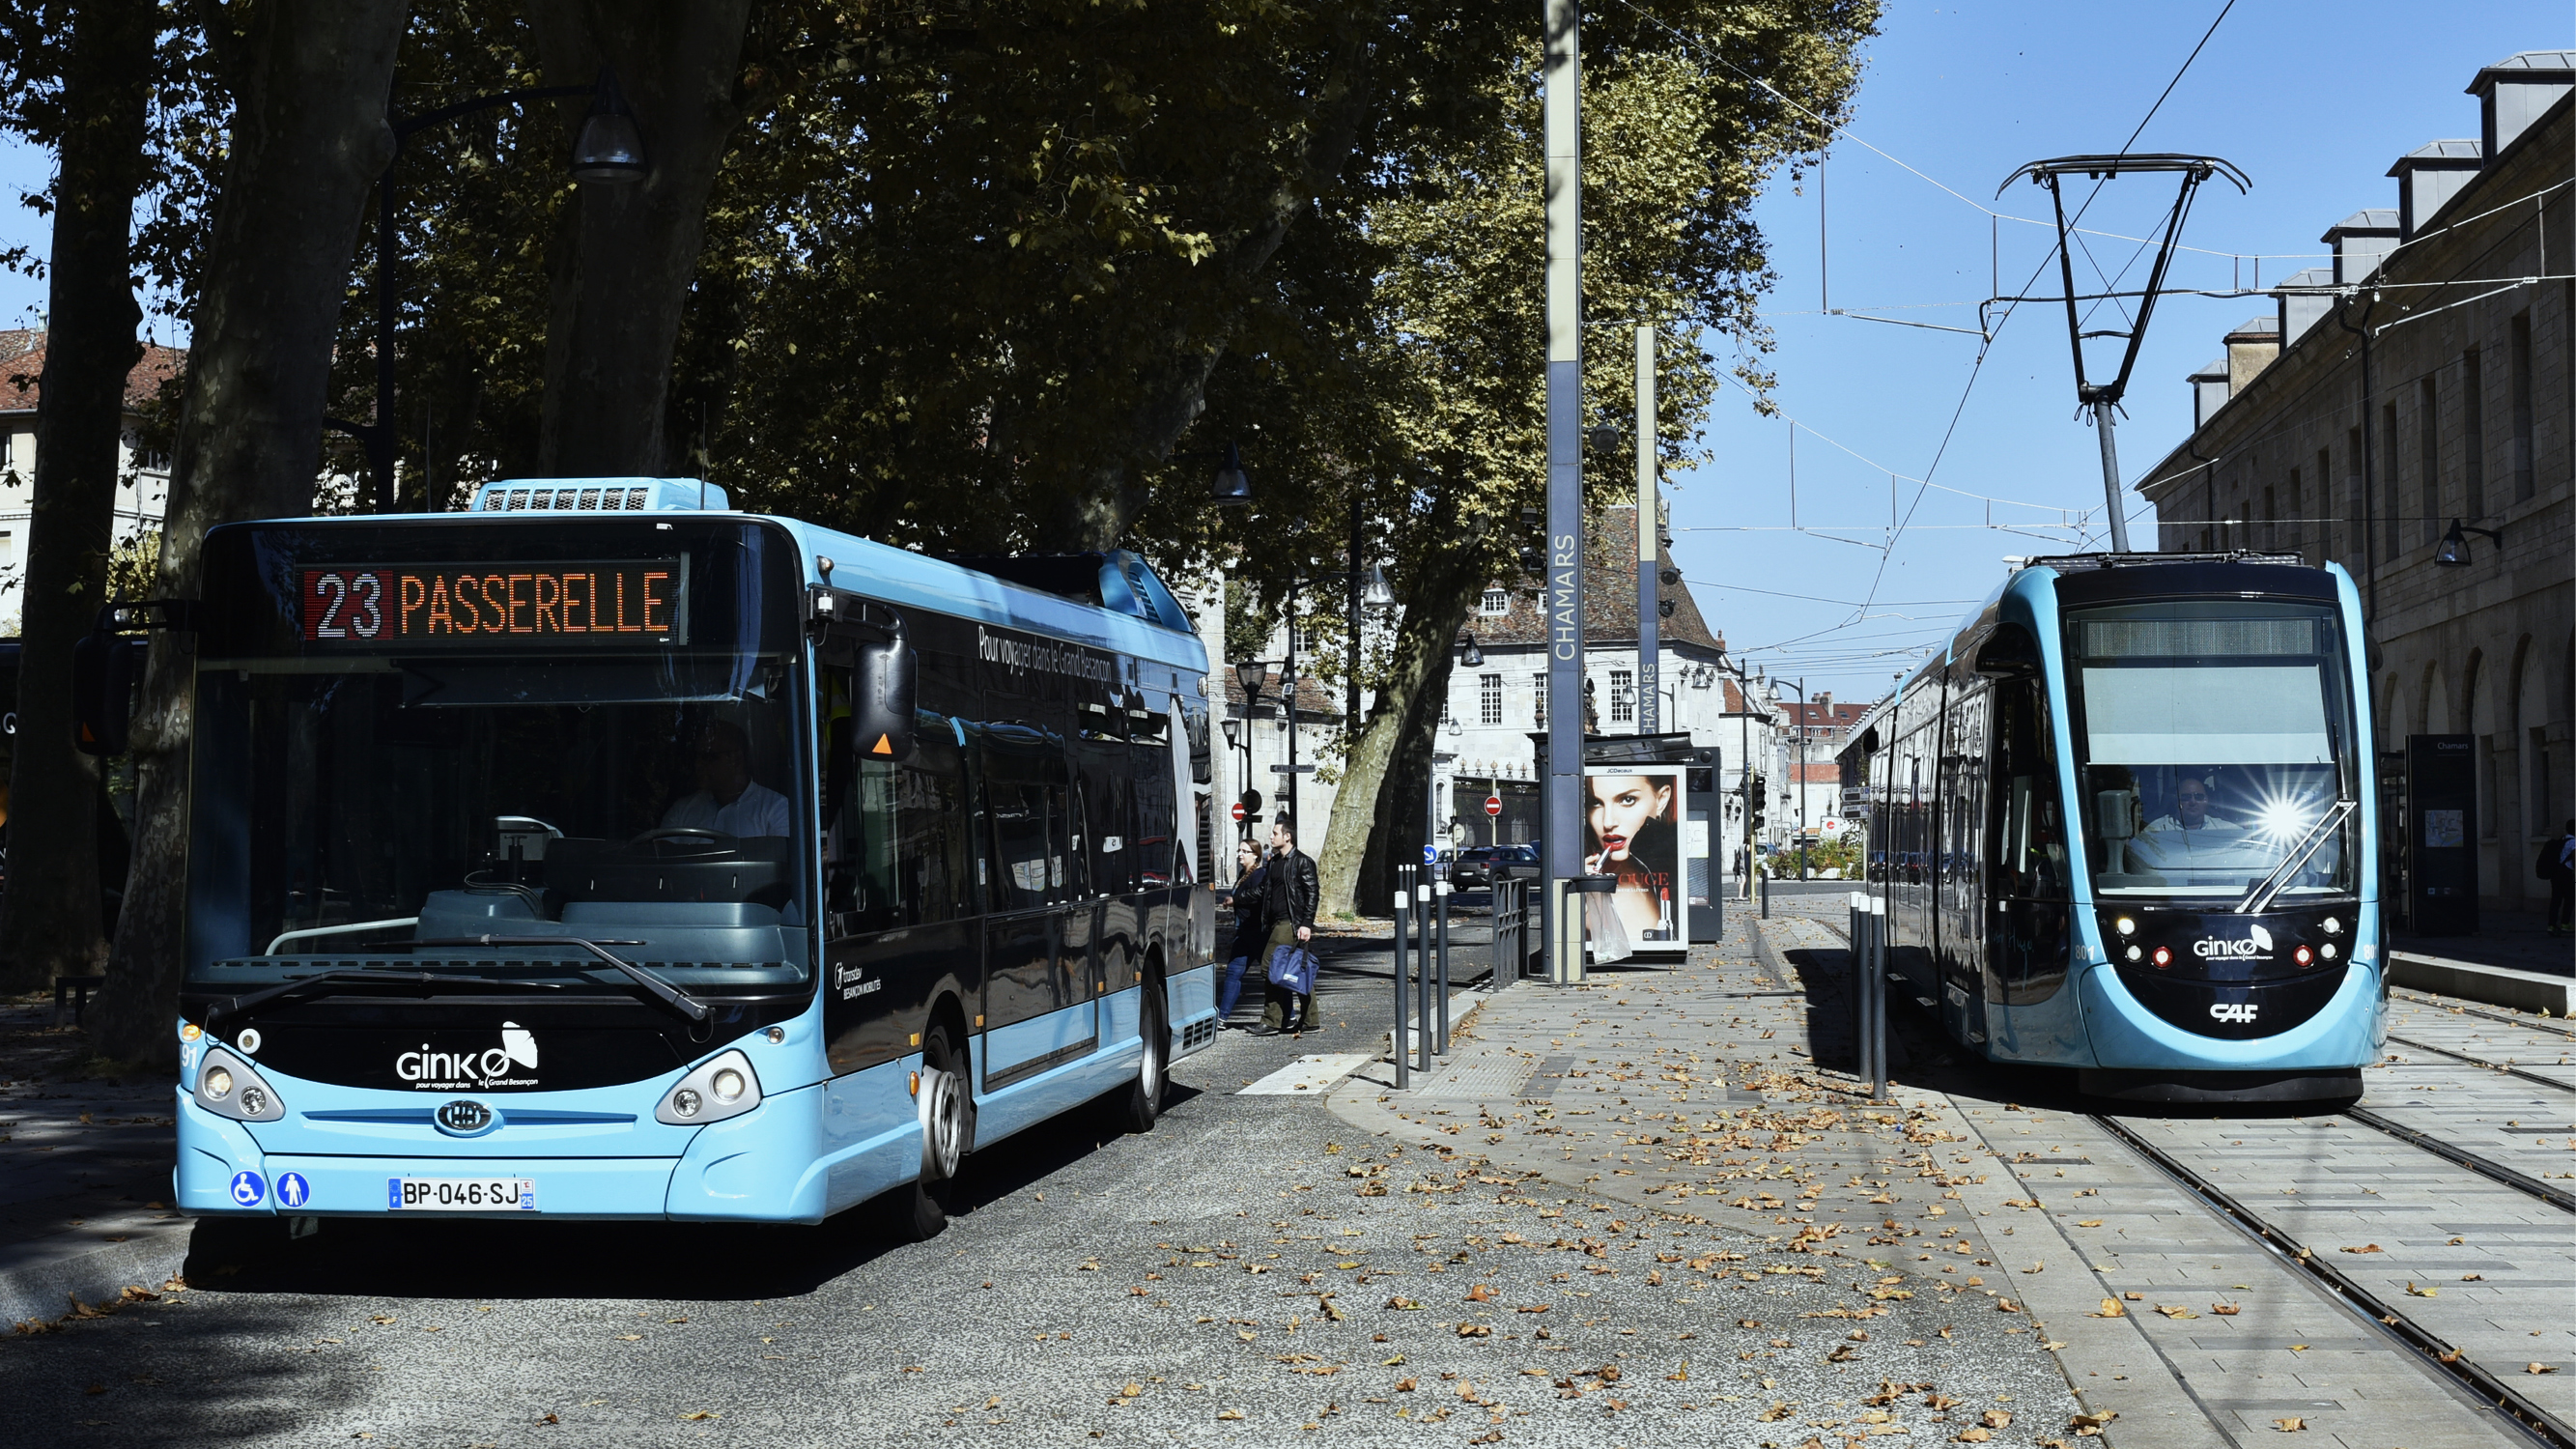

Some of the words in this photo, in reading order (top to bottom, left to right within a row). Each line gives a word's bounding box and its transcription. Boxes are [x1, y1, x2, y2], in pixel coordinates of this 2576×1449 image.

[317, 573, 382, 638] 23
[401, 572, 668, 634] PASSERELLE
[1554, 534, 1576, 661] CHAMARS
[978, 624, 999, 663] Pour
[999, 638, 1032, 676] voyager
[1032, 636, 1050, 672] dans
[1051, 639, 1059, 673] le
[1059, 641, 1080, 677] Grand
[1080, 647, 1111, 690] Besançon
[1618, 871, 1670, 886] OUGE
[2075, 945, 2096, 961] 801
[2210, 1004, 2258, 1023] CAF
[182, 1043, 198, 1070] 91
[431, 1082, 455, 1091] voyager
[508, 1078, 539, 1087] Besançon
[404, 1182, 519, 1205] BP-046-SJ
[522, 1196, 533, 1208] 25
